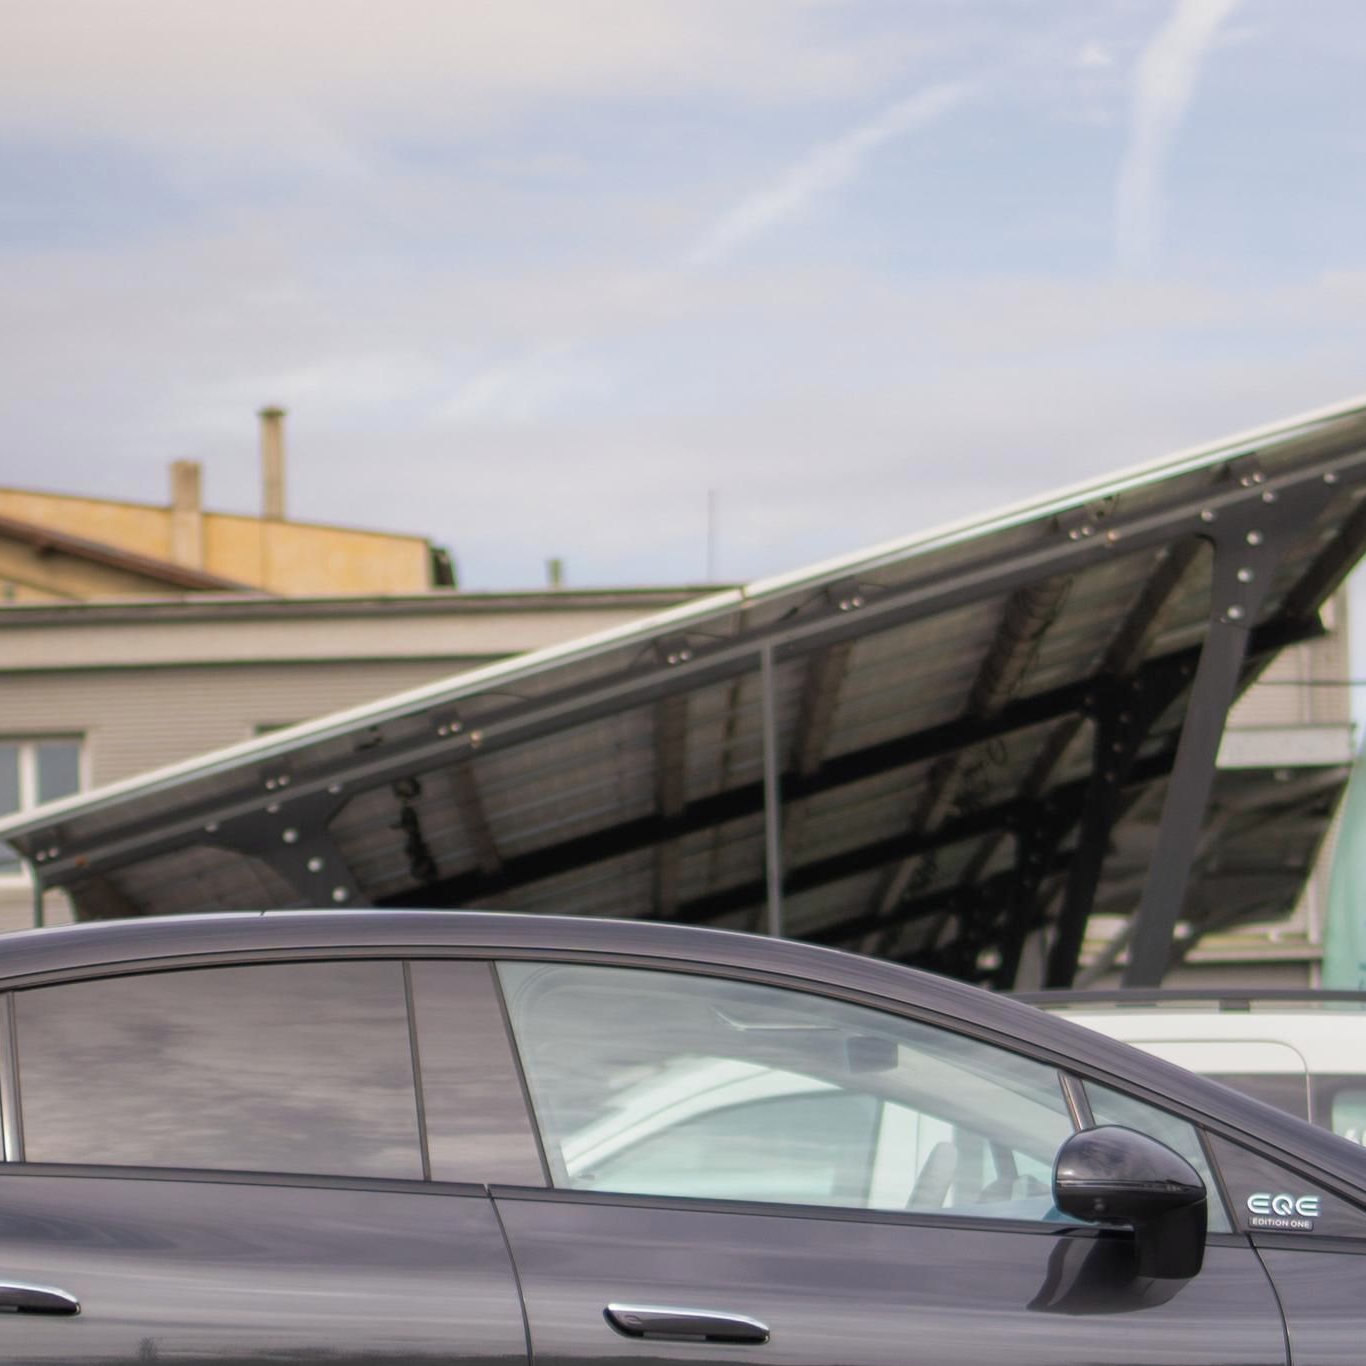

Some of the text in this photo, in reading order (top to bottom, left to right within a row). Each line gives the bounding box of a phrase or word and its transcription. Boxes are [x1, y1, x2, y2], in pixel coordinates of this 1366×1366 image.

[1247, 1193, 1319, 1216] EQE
[1252, 1217, 1310, 1229] EDITION ONE
